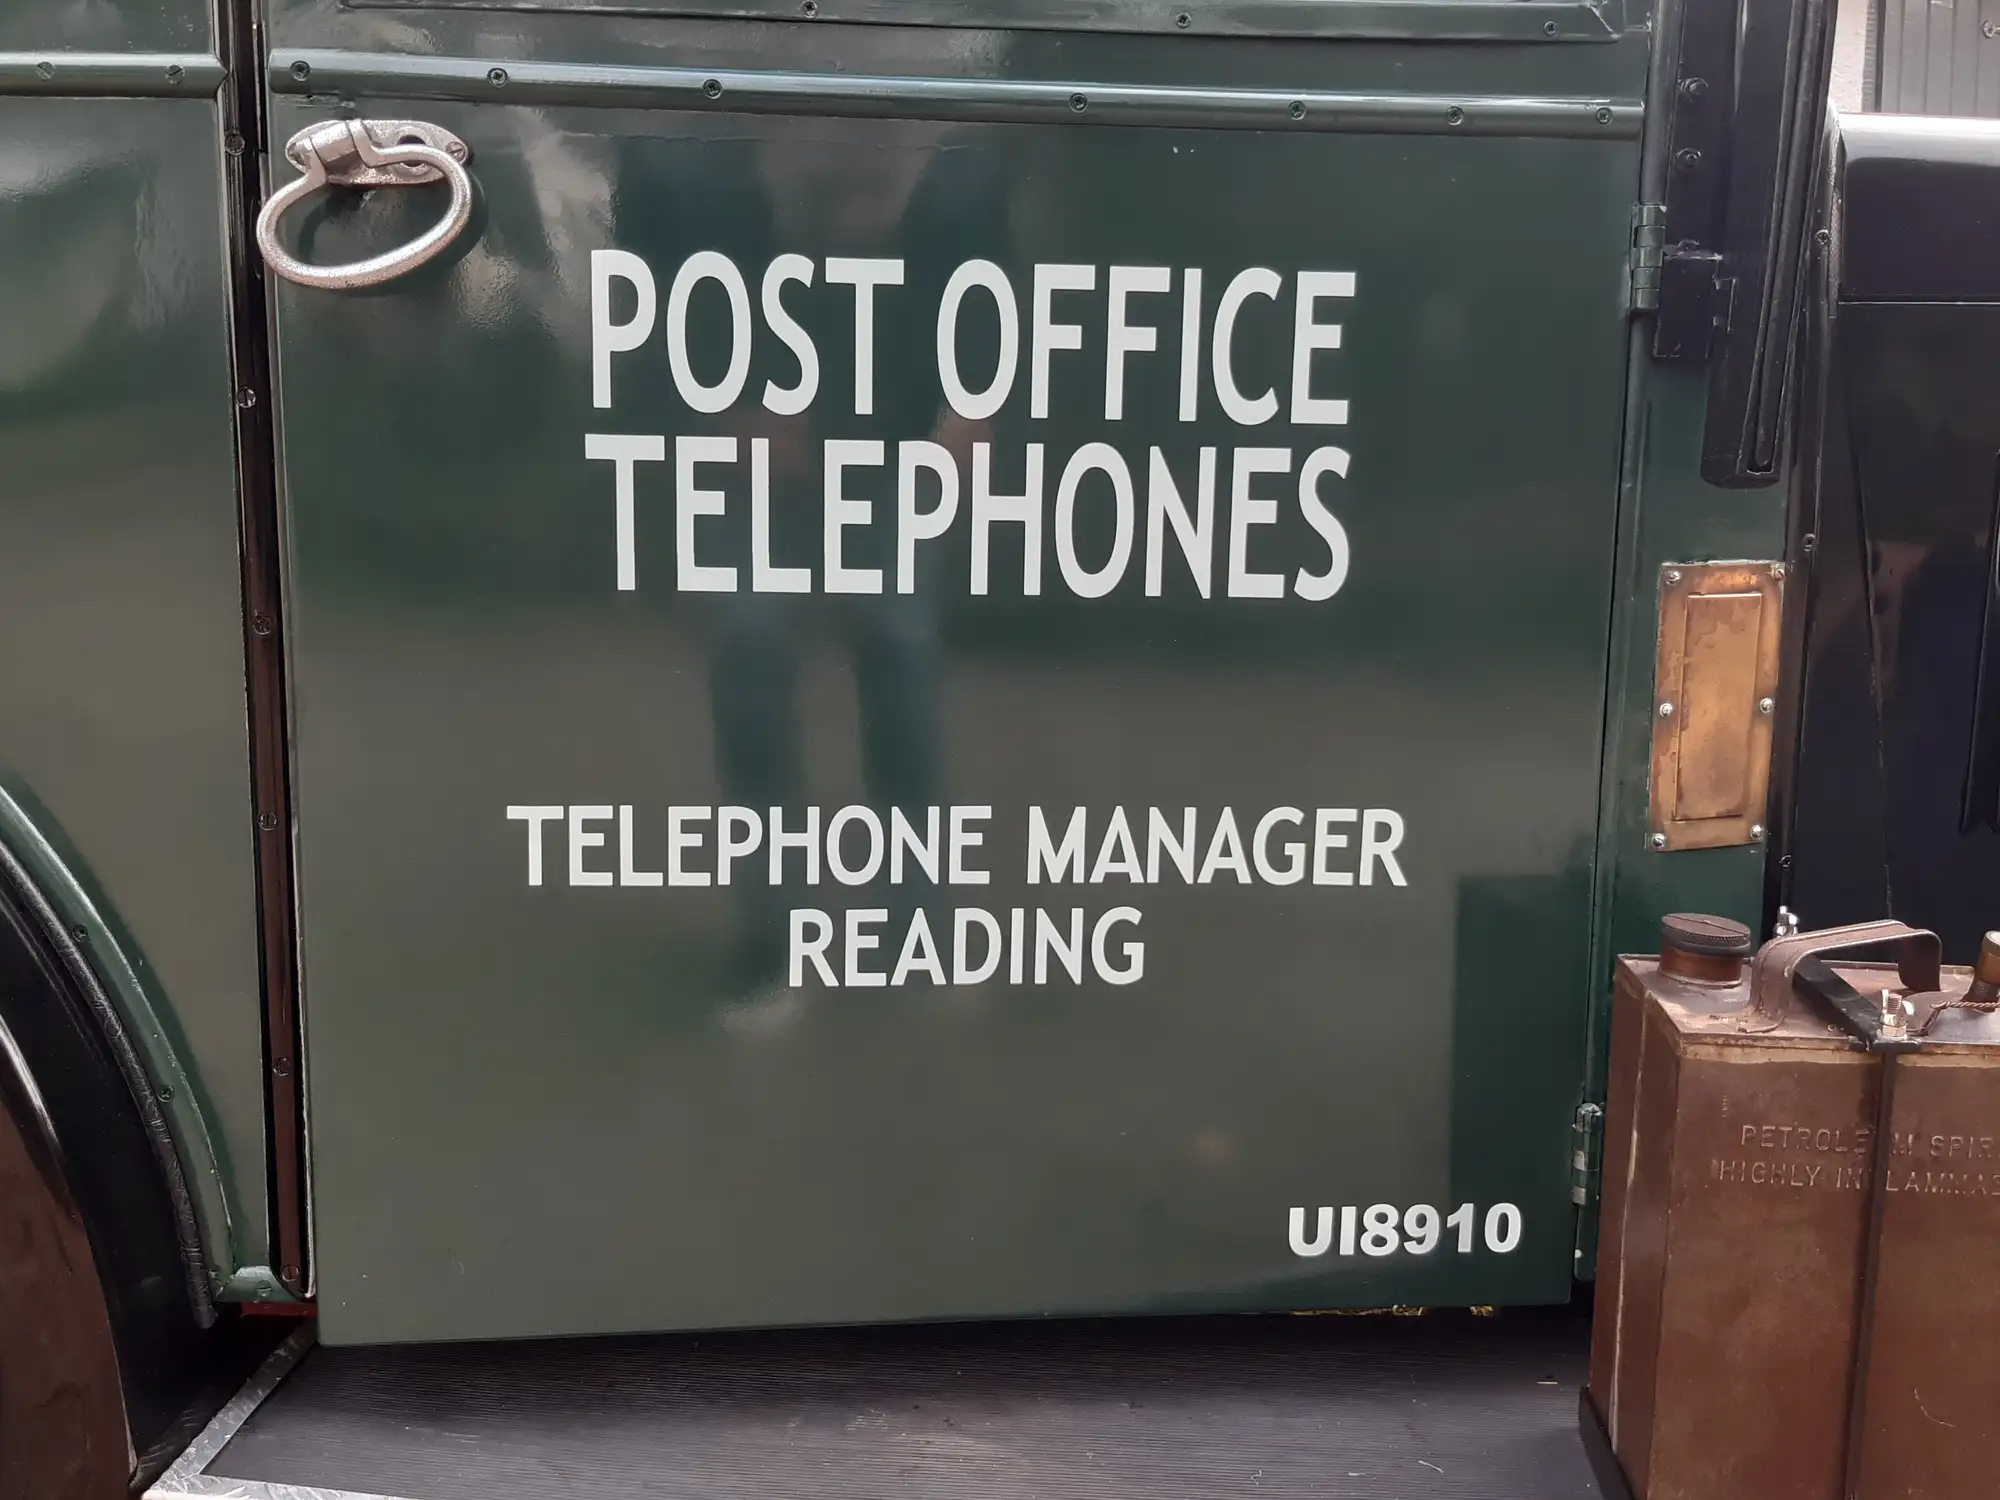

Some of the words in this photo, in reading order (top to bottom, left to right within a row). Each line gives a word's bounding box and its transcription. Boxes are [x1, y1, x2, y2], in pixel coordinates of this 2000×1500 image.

[591, 249, 905, 416] POST
[937, 259, 1356, 426] OFFICE
[585, 434, 1351, 602] TELEPHONES
[507, 805, 992, 887] TELEPHONE
[1027, 806, 1408, 887] MANAGER
[789, 907, 1145, 988] READING
[1719, 1159, 1822, 1187] HIGHLY
[1741, 1124, 1914, 1156] PETROLEM
[1929, 1133, 2000, 1161] SPIR
[1289, 1203, 1522, 1257] UI8910
